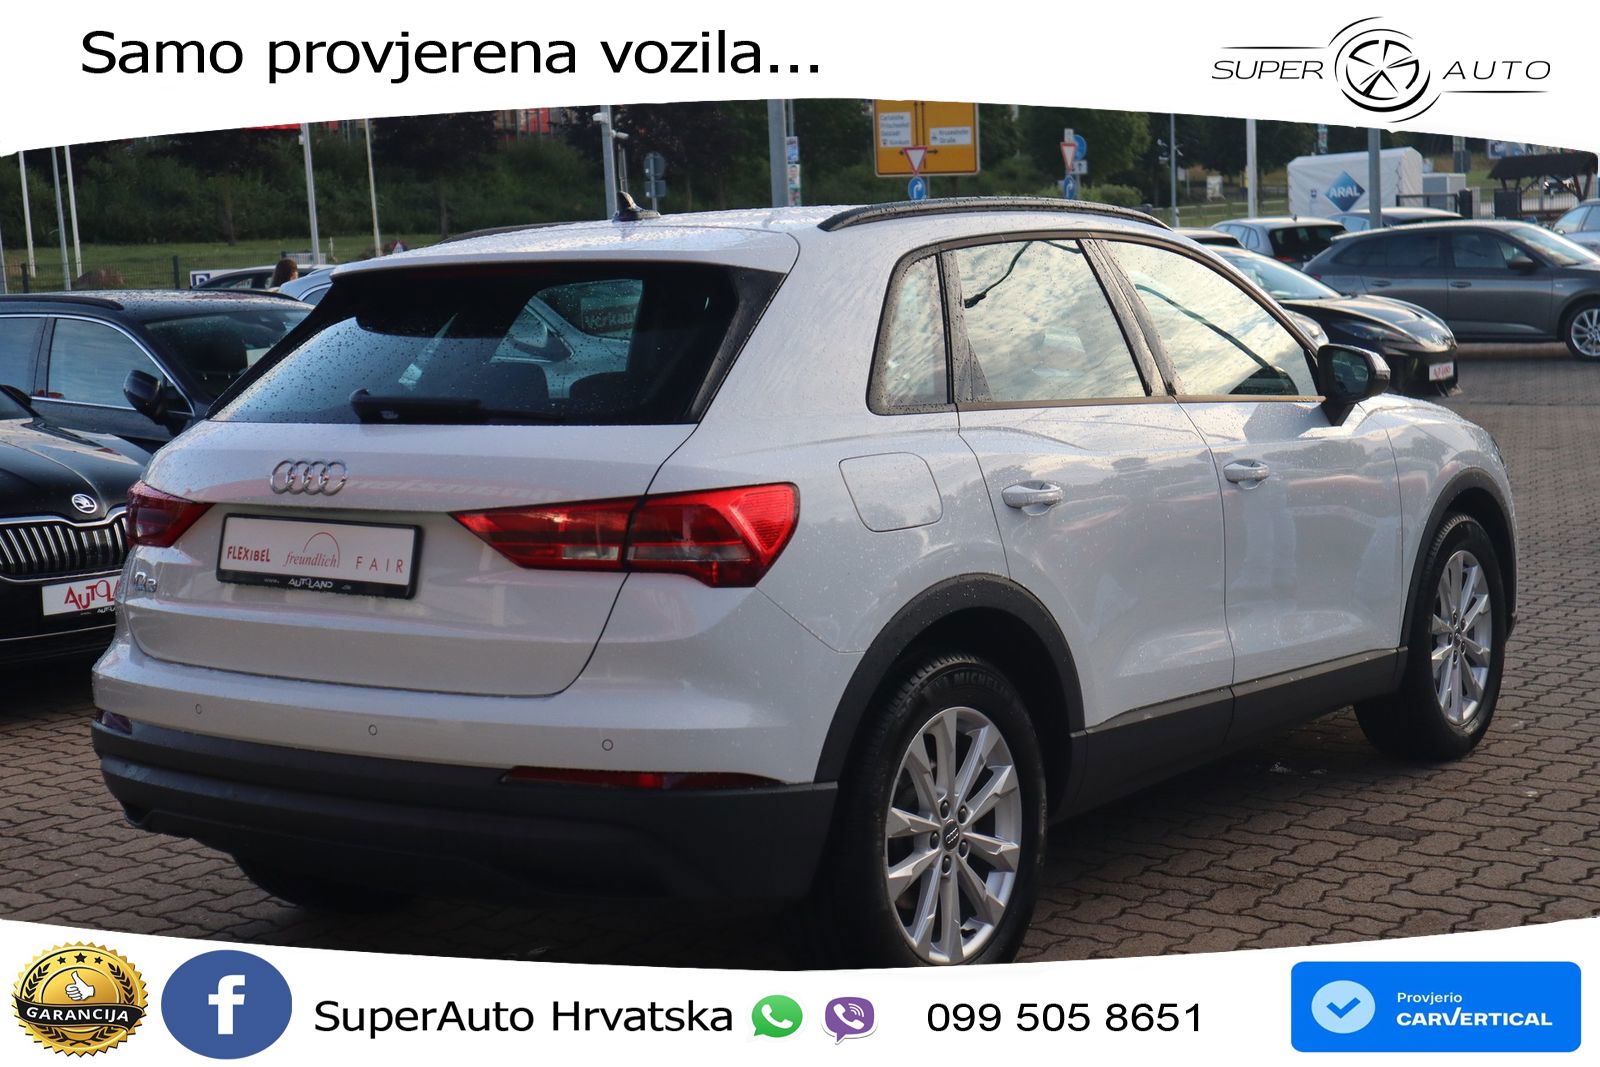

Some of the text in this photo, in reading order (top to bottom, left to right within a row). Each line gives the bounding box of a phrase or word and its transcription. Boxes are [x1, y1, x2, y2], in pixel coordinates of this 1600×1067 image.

[1329, 186, 1360, 198] ARAL
[226, 546, 404, 574] FLEXIBEL freundlich FAIR
[288, 578, 334, 589] AUTOLAND
